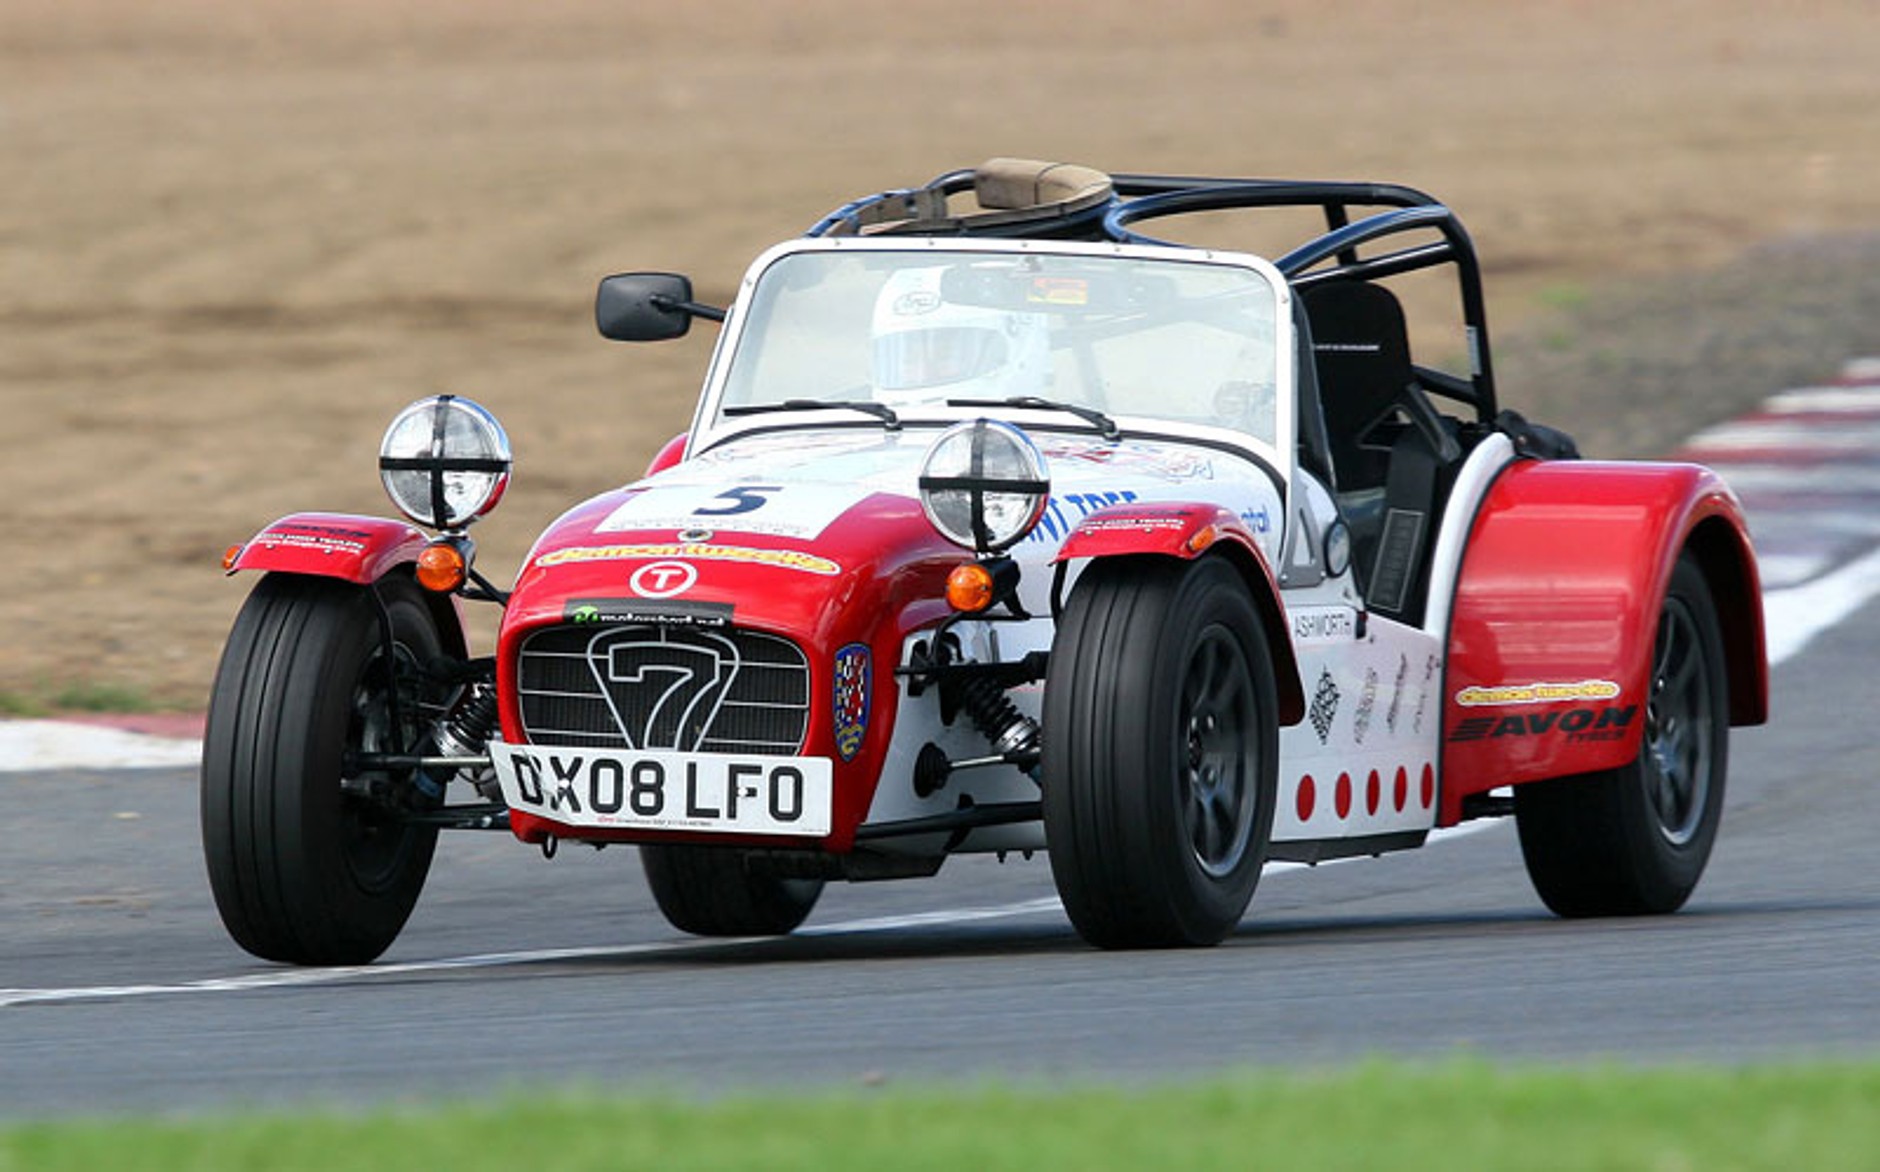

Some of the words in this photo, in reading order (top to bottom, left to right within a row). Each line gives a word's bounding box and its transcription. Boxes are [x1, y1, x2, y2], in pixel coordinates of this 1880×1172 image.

[691, 486, 784, 515] 5
[650, 568, 683, 590] T
[609, 640, 720, 751] 7
[1491, 704, 1638, 737] AVON
[510, 752, 665, 817] DX08
